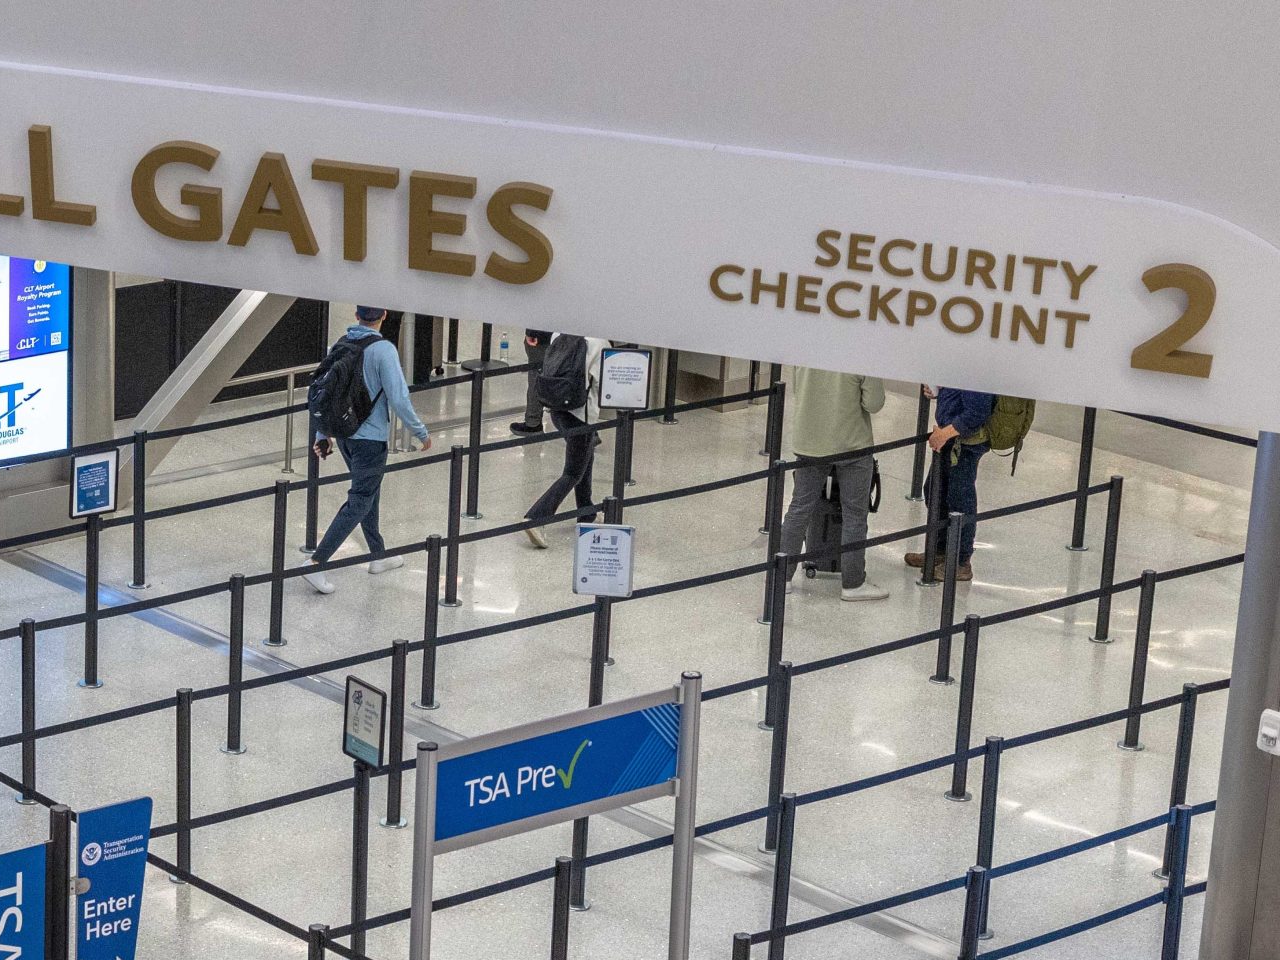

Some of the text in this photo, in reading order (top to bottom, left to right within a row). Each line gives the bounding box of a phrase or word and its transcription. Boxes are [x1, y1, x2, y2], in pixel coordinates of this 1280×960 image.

[131, 140, 554, 285] GATES
[815, 229, 1098, 300] SECURITY
[16, 290, 62, 302] Royalty Program
[35, 282, 55, 291] Airport
[709, 264, 1090, 349] CHECKPOINT
[1131, 262, 1217, 379] 2
[19, 336, 37, 349] CLT
[464, 765, 556, 807] TSA Pre
[103, 834, 144, 848] Transportation
[103, 845, 126, 855] Security
[103, 847, 144, 861] Administration
[83, 894, 135, 919] Enter
[86, 917, 132, 941] Here
